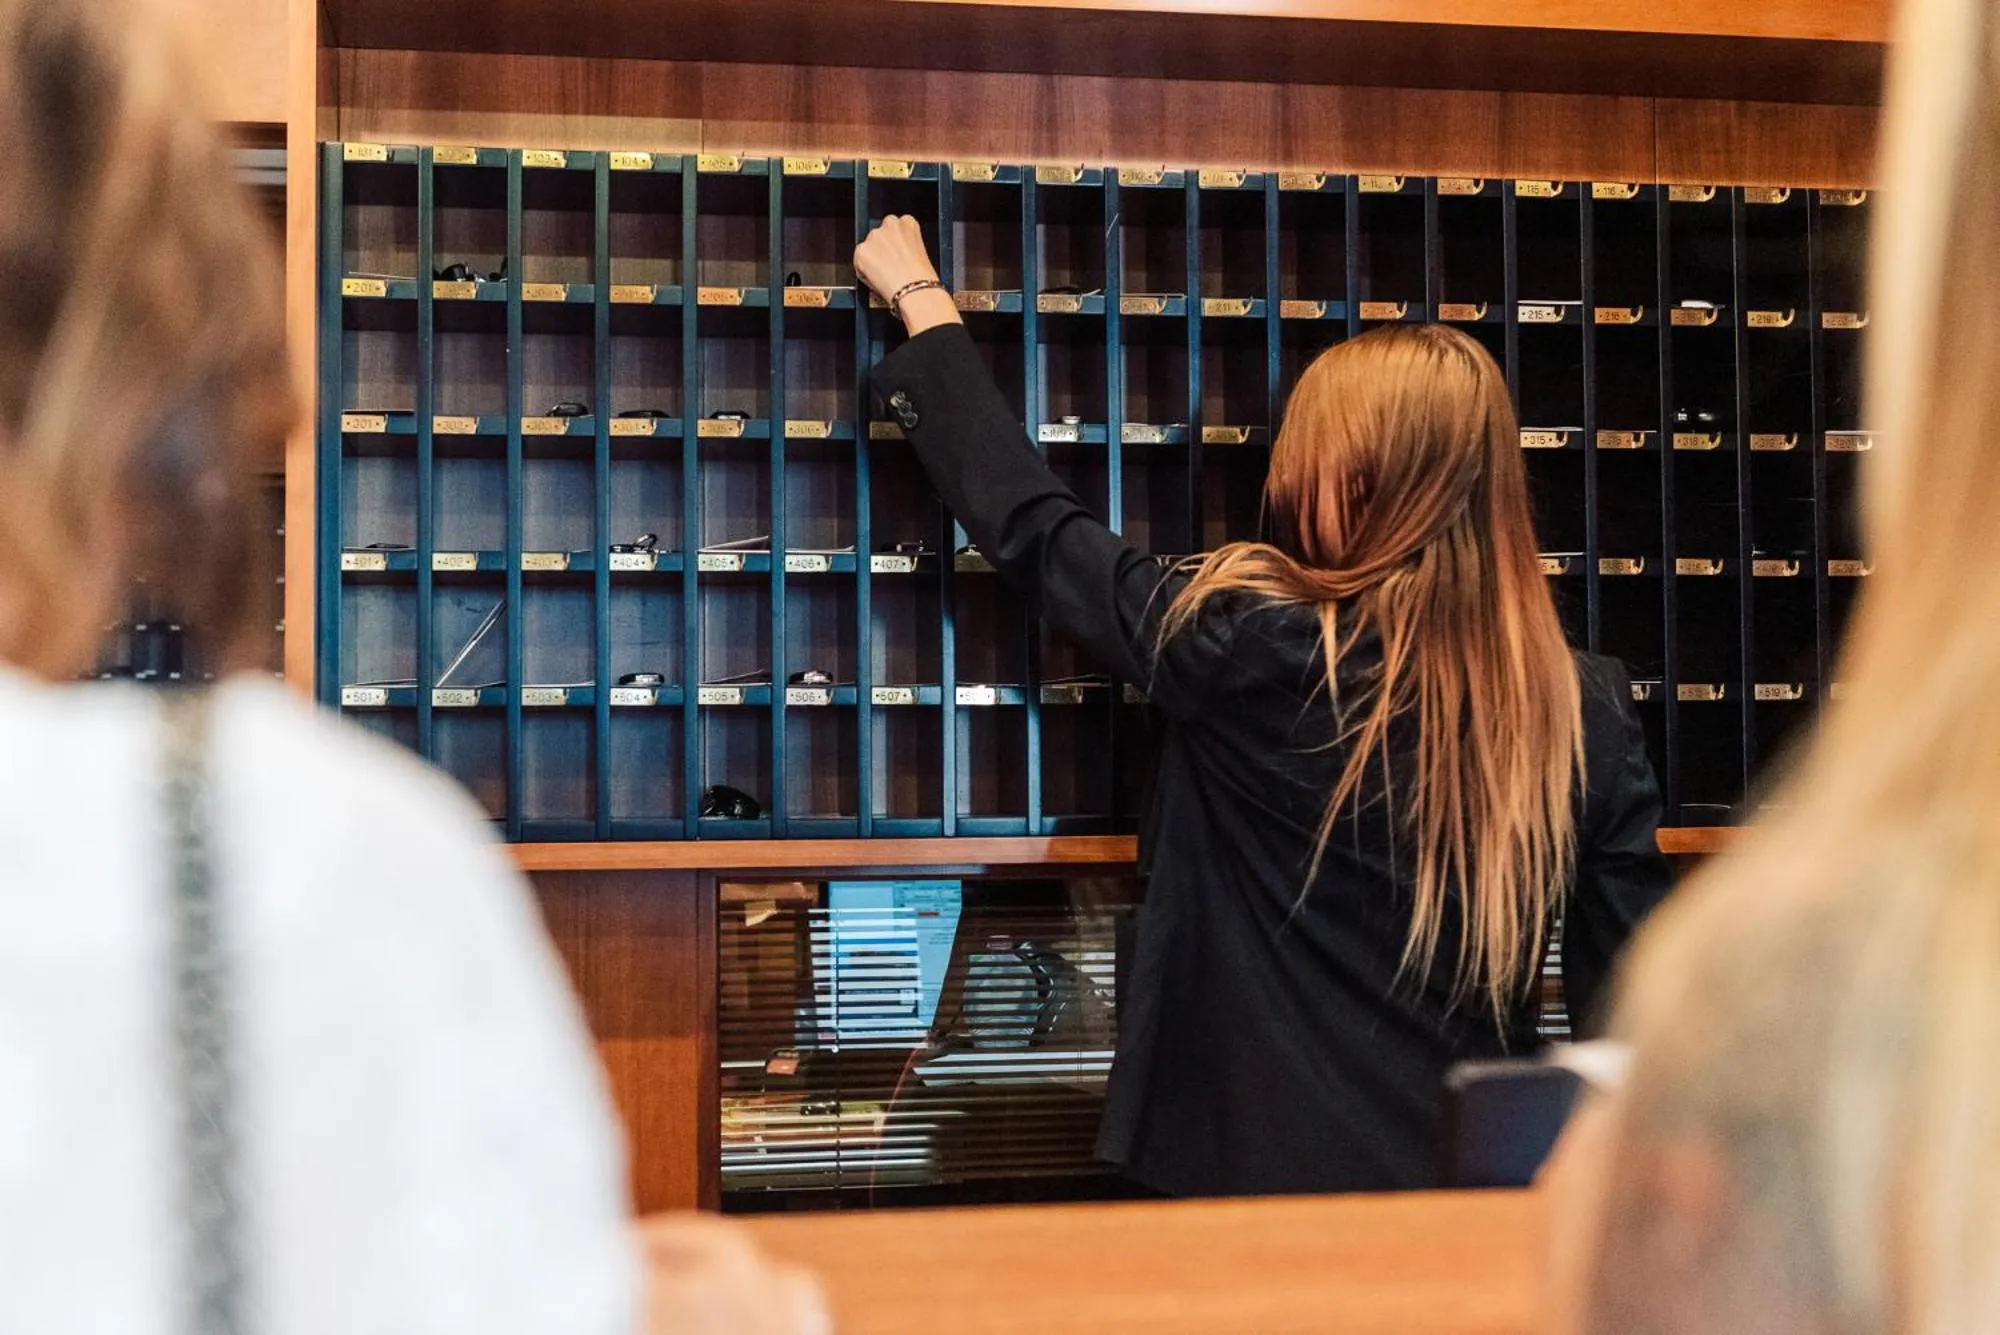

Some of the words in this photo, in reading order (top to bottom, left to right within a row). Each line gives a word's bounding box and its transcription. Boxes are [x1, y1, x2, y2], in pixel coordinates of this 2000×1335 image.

[353, 284, 373, 293] 201
[1216, 303, 1231, 313] 211
[1528, 310, 1543, 320] 215
[1605, 311, 1620, 321] 216
[353, 419, 372, 429] 301
[1530, 435, 1546, 445] 315
[1682, 437, 1698, 446] 318
[442, 557, 463, 567] 402
[619, 557, 640, 568] 404
[708, 558, 728, 568] 405
[794, 558, 815, 569] 406
[880, 559, 899, 569] 407
[353, 692, 372, 702] 501
[442, 693, 463, 703] 502
[532, 692, 552, 702] 503
[619, 692, 640, 702] 504
[708, 691, 729, 701] 505
[795, 691, 816, 701] 506
[880, 691, 899, 701] 507
